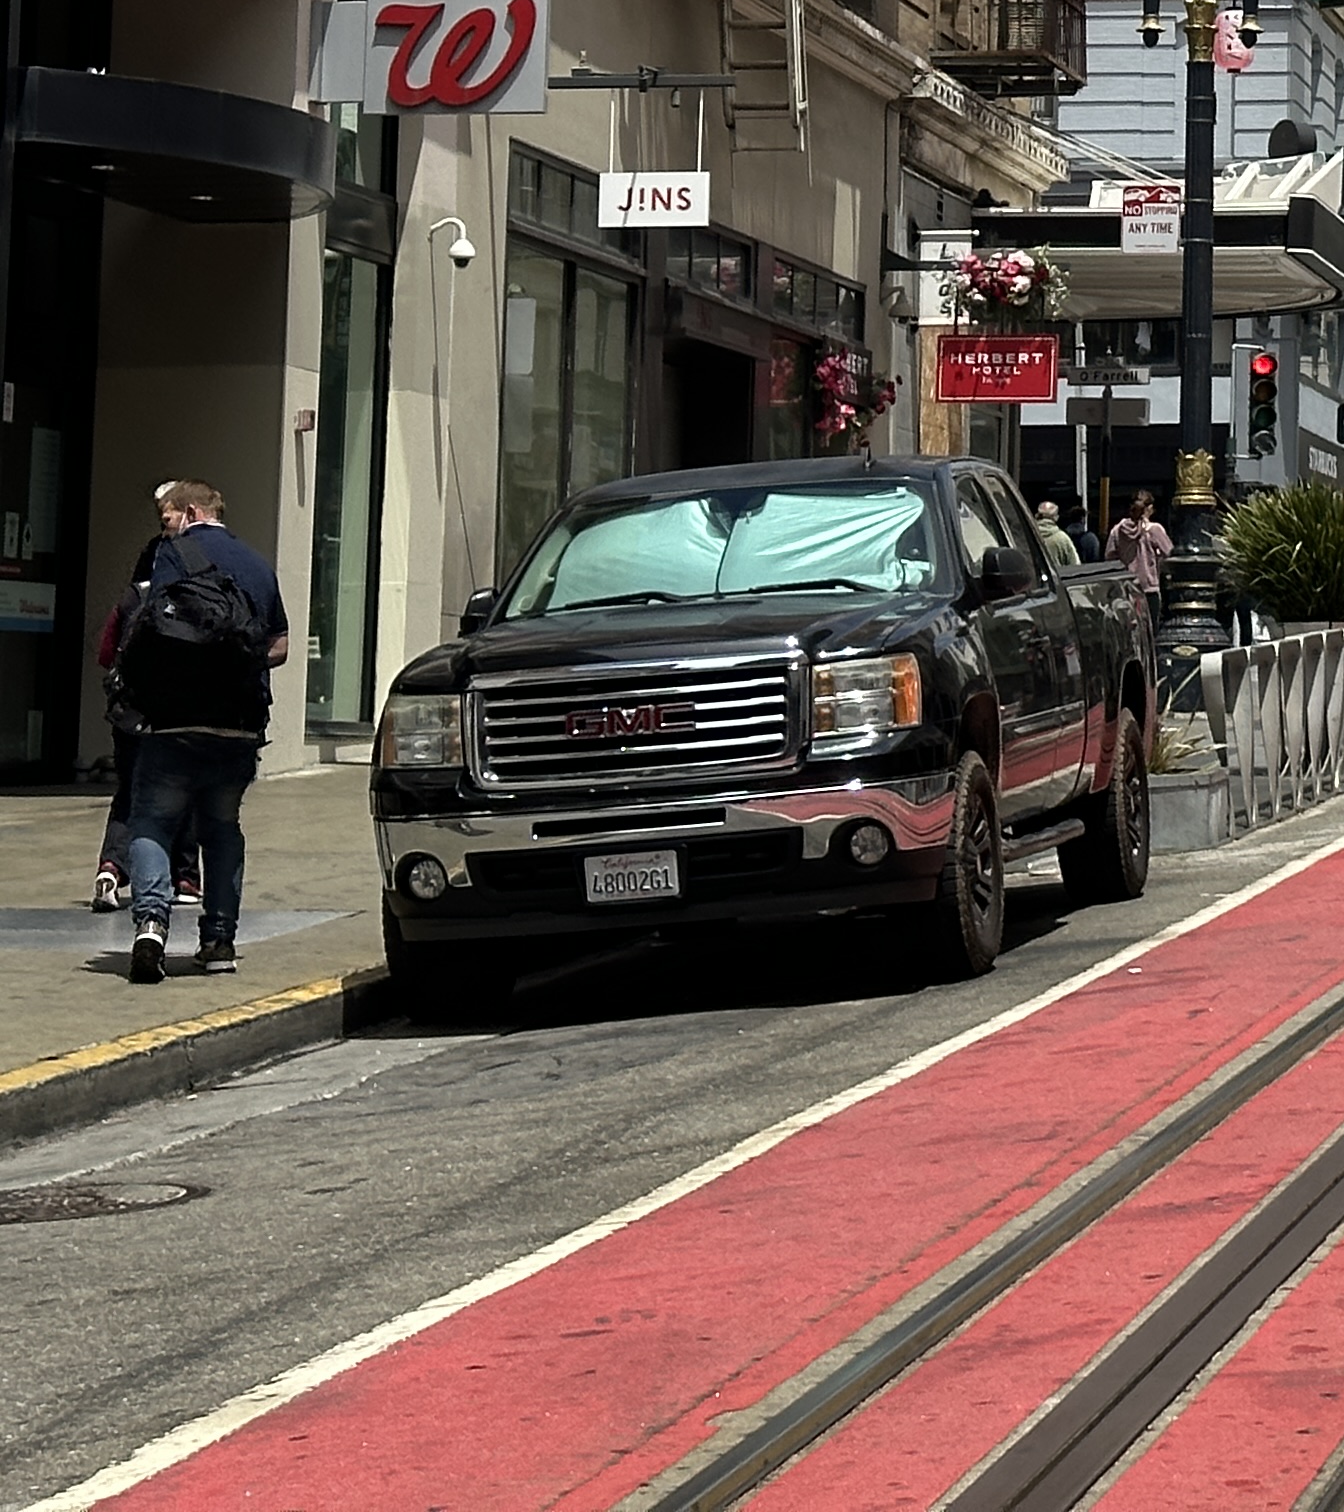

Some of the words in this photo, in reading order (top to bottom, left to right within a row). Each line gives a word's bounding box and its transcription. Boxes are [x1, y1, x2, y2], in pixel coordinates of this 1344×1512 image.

[1124, 204, 1142, 215] NO
[1144, 205, 1178, 215] STOPPING
[1128, 222, 1149, 234] ANY
[1150, 222, 1174, 234] TIME
[950, 352, 1044, 365] HERBERT
[972, 365, 1022, 375] HOTEL
[565, 701, 696, 738] GMC
[592, 868, 674, 894] 48002G1
